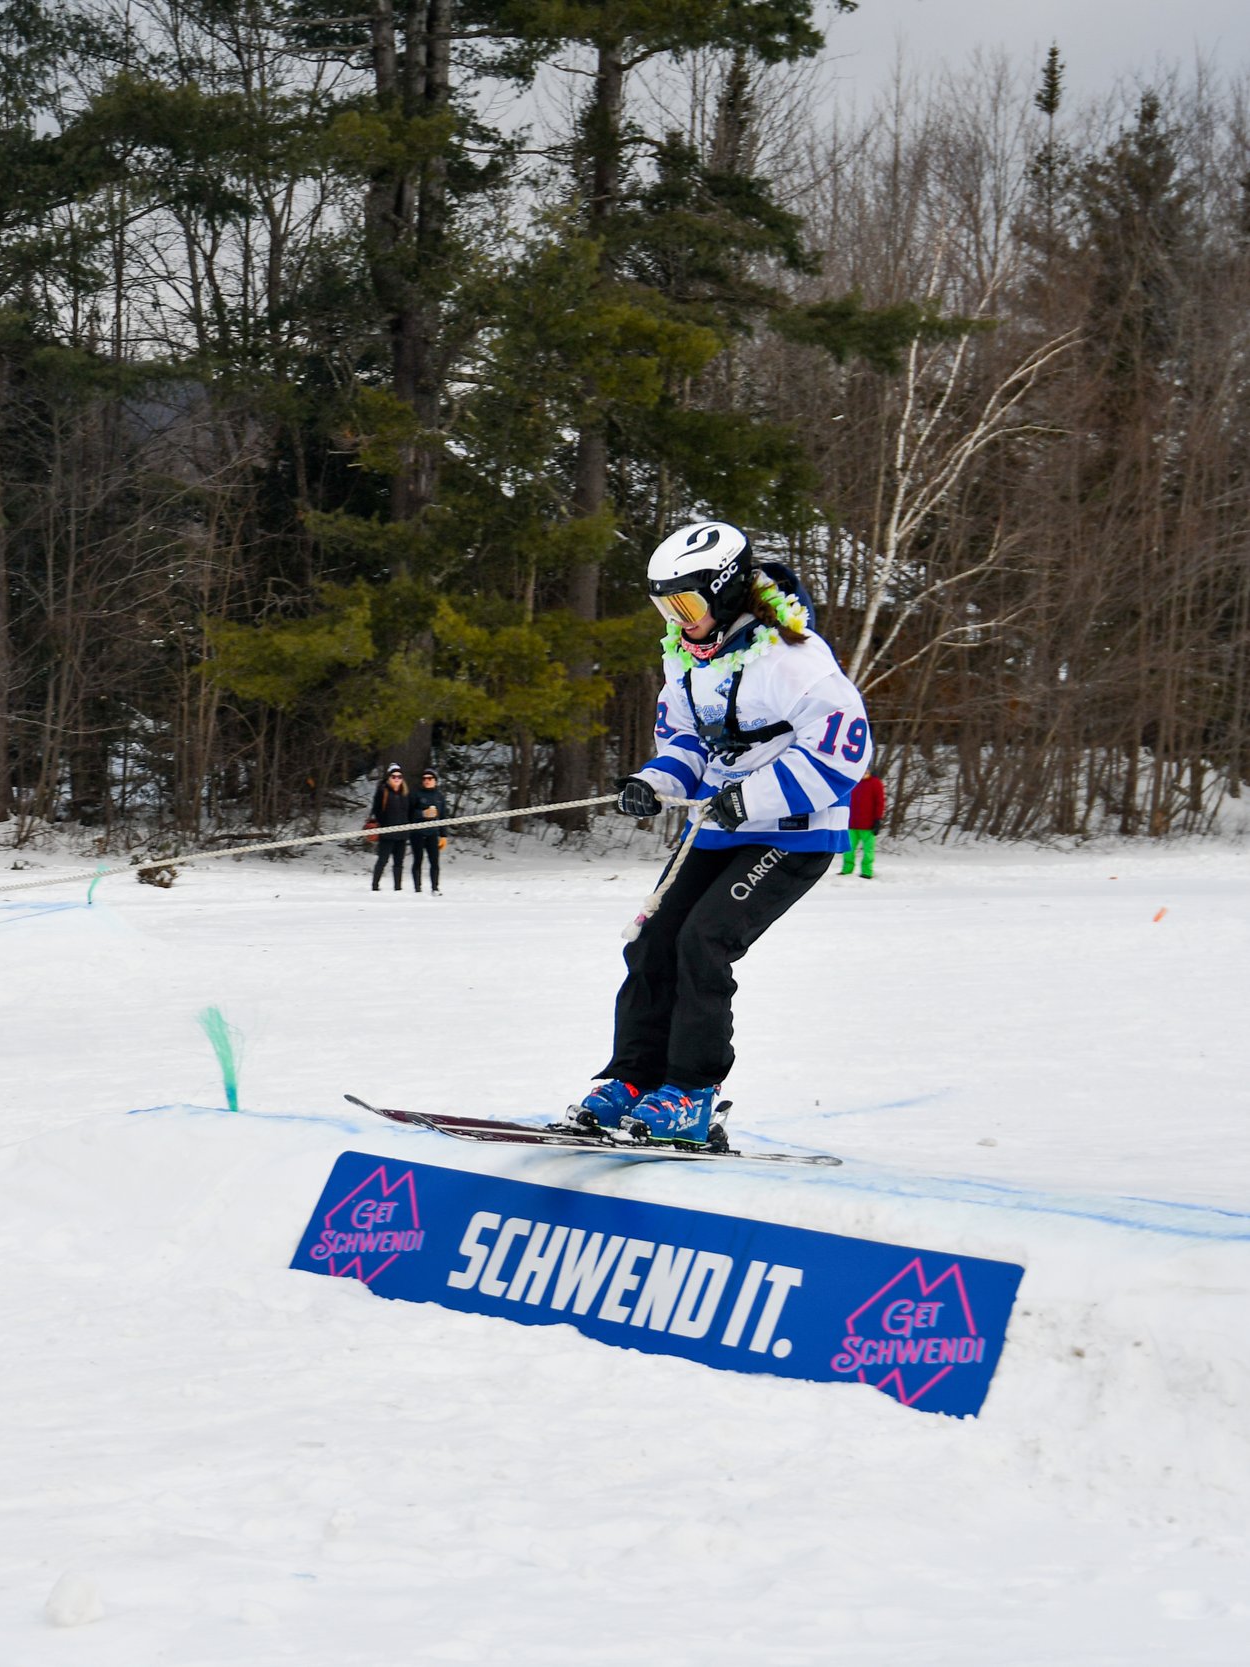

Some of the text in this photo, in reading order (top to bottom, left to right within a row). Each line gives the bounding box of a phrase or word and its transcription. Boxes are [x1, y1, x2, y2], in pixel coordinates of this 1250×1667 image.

[817, 710, 867, 763] 19
[350, 1199, 399, 1231] GET
[310, 1229, 426, 1260] SCHWENDI
[446, 1210, 804, 1359] SCHWEND IT.
[881, 1298, 944, 1338] GET
[830, 1335, 987, 1373] SCHWENDI
